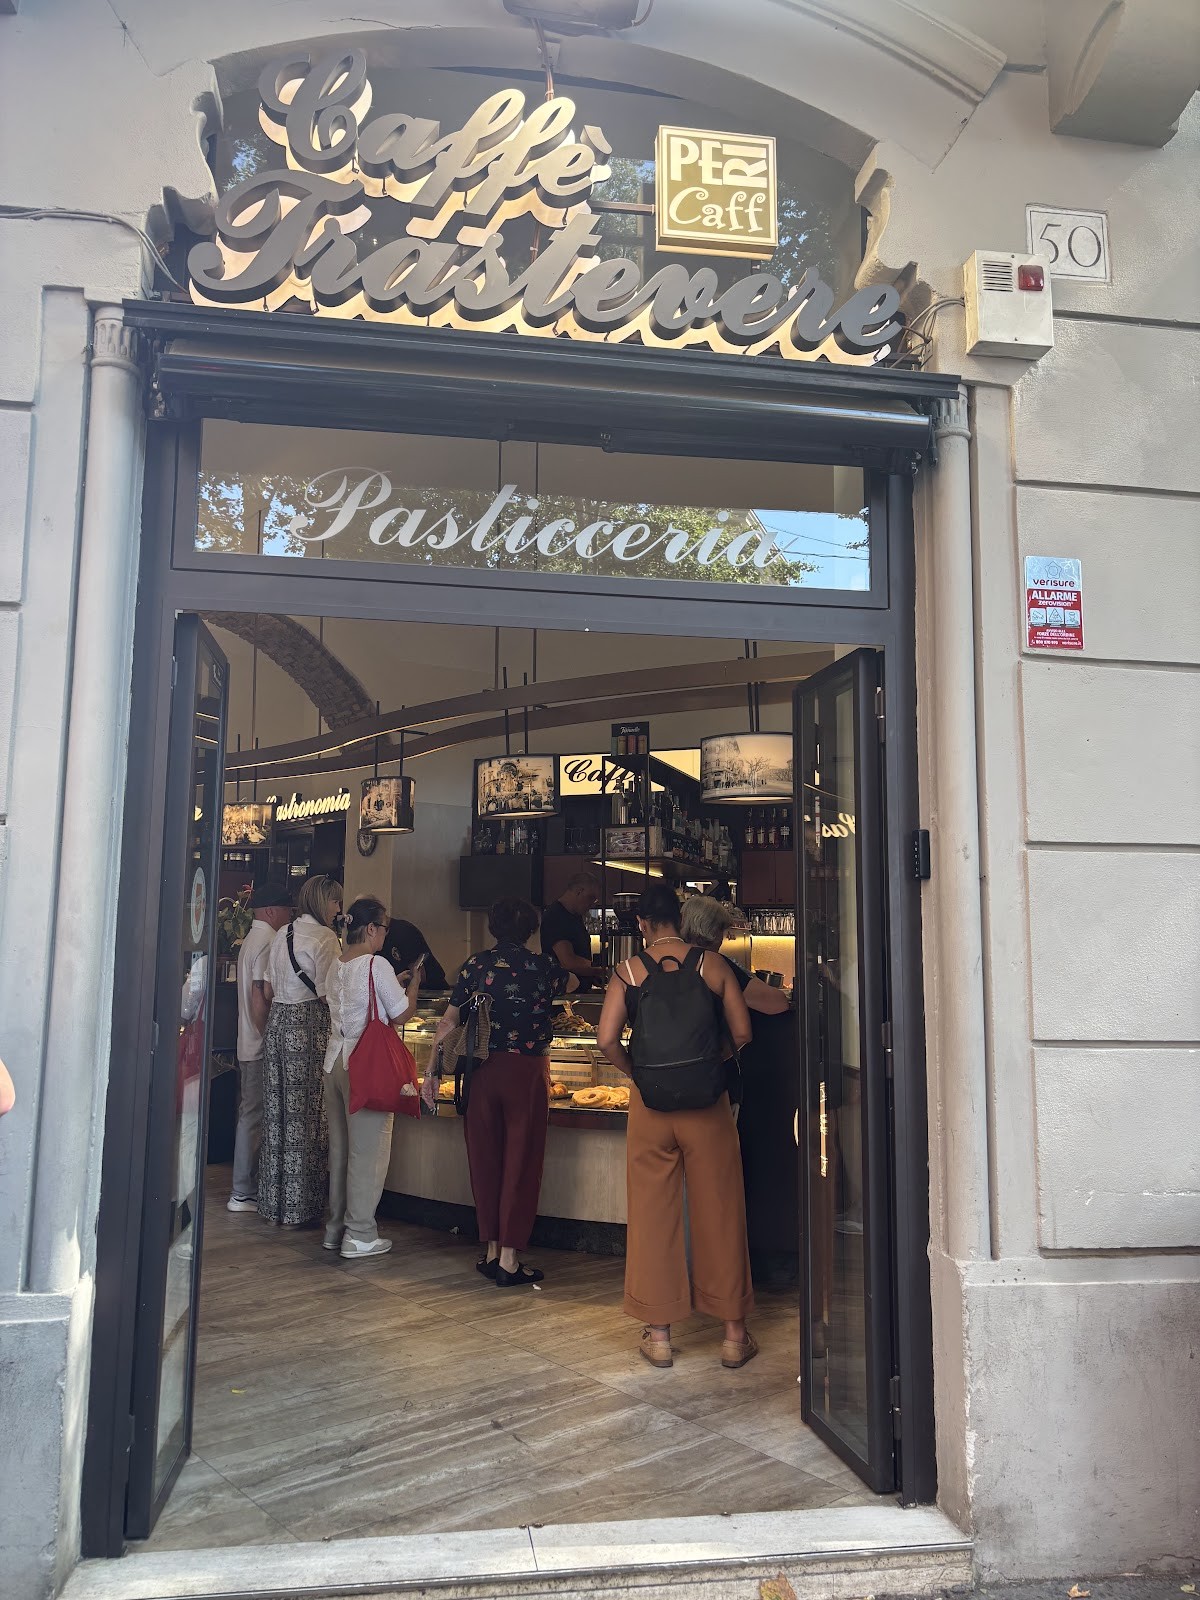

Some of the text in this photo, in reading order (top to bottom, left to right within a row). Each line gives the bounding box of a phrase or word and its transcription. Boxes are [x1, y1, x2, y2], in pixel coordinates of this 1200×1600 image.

[257, 48, 612, 228] Caffè
[669, 186, 767, 233] Caff
[188, 169, 902, 360] Trastevere
[1040, 223, 1101, 267] 50
[290, 467, 799, 568] Pasticceria
[1031, 590, 1078, 602] ALLARME
[1033, 578, 1075, 587] verisure
[563, 758, 636, 792] Caff
